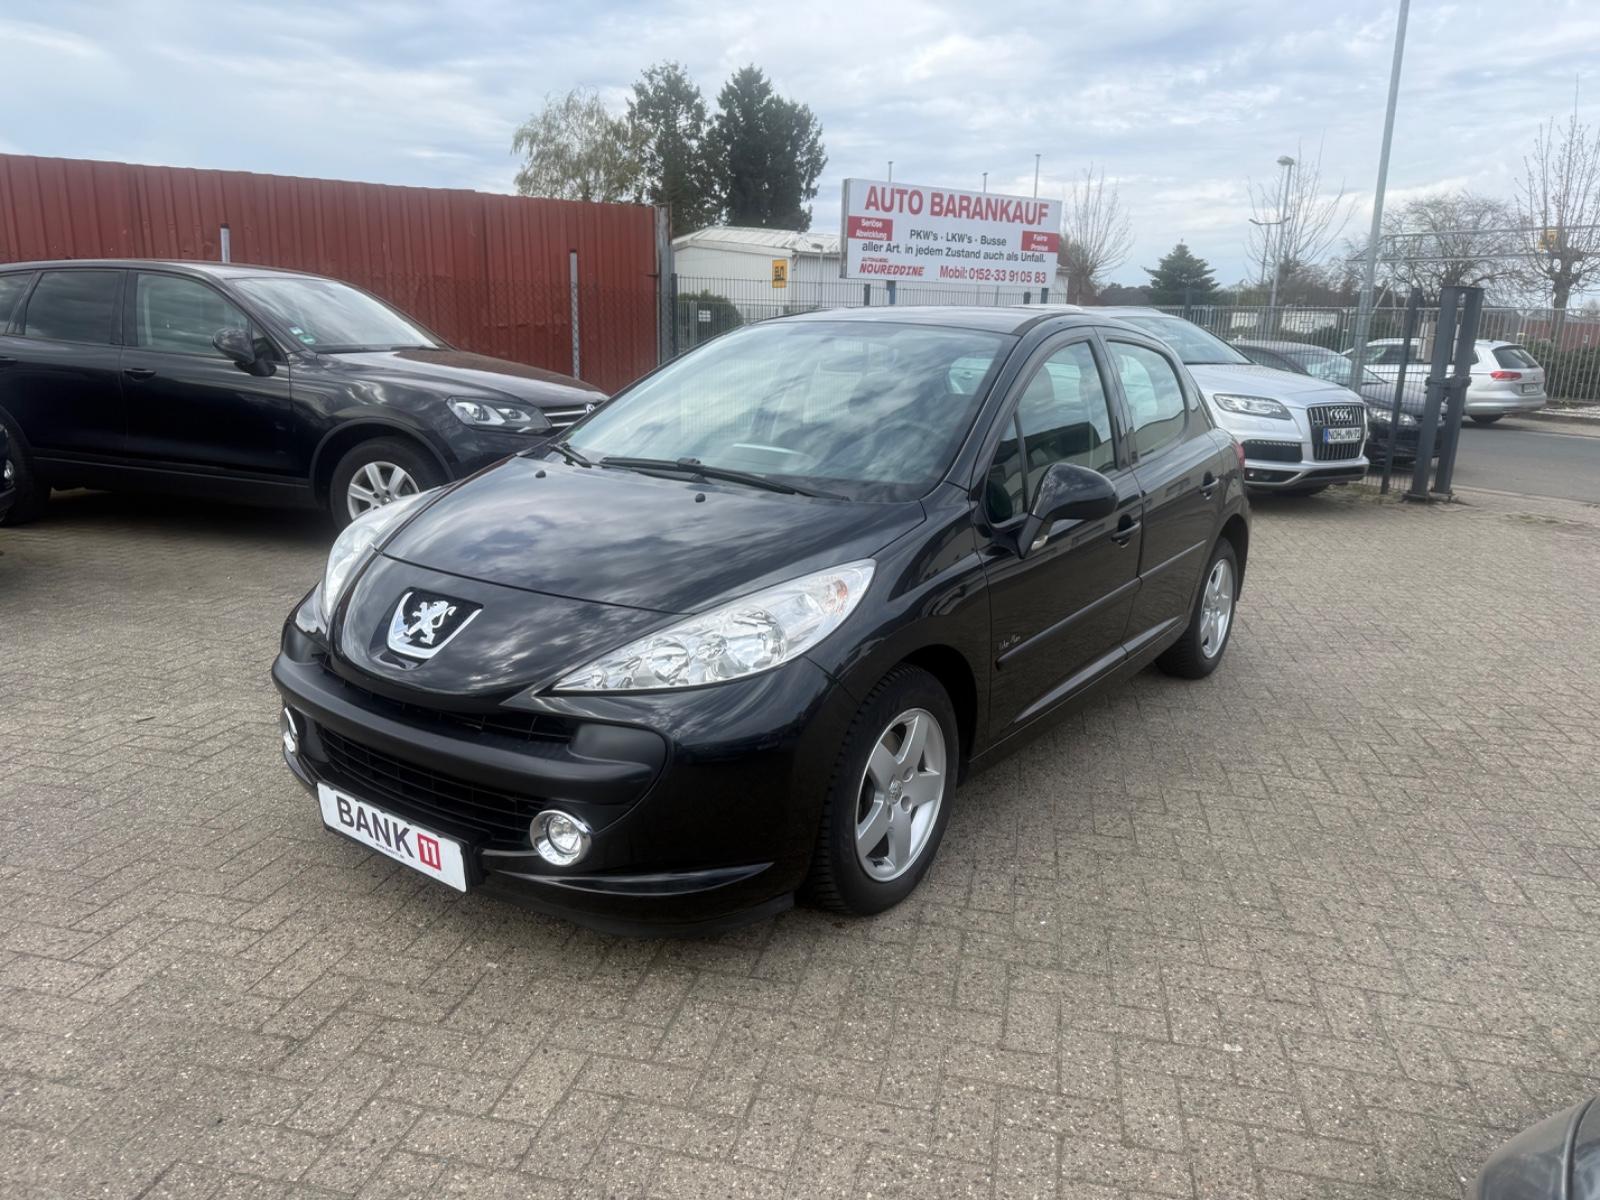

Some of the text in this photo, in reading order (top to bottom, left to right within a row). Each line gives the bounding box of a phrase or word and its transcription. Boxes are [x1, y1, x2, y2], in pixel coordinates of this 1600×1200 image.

[864, 186, 1049, 226] AUTO BARANKAUF
[910, 229, 938, 241] PKW's
[946, 232, 972, 244] LKW's
[980, 235, 1007, 246] Busse
[862, 242, 883, 252] aller
[905, 244, 913, 254] in
[915, 244, 943, 257] jedem
[945, 247, 980, 259] Zustand
[983, 251, 1004, 260] auch
[1006, 252, 1019, 261] als
[859, 263, 925, 277] NOUREDDINE
[939, 265, 967, 277] Mobil:
[968, 267, 1007, 281] 0152-33
[1034, 272, 1047, 284] 83
[336, 795, 414, 859] BANK
